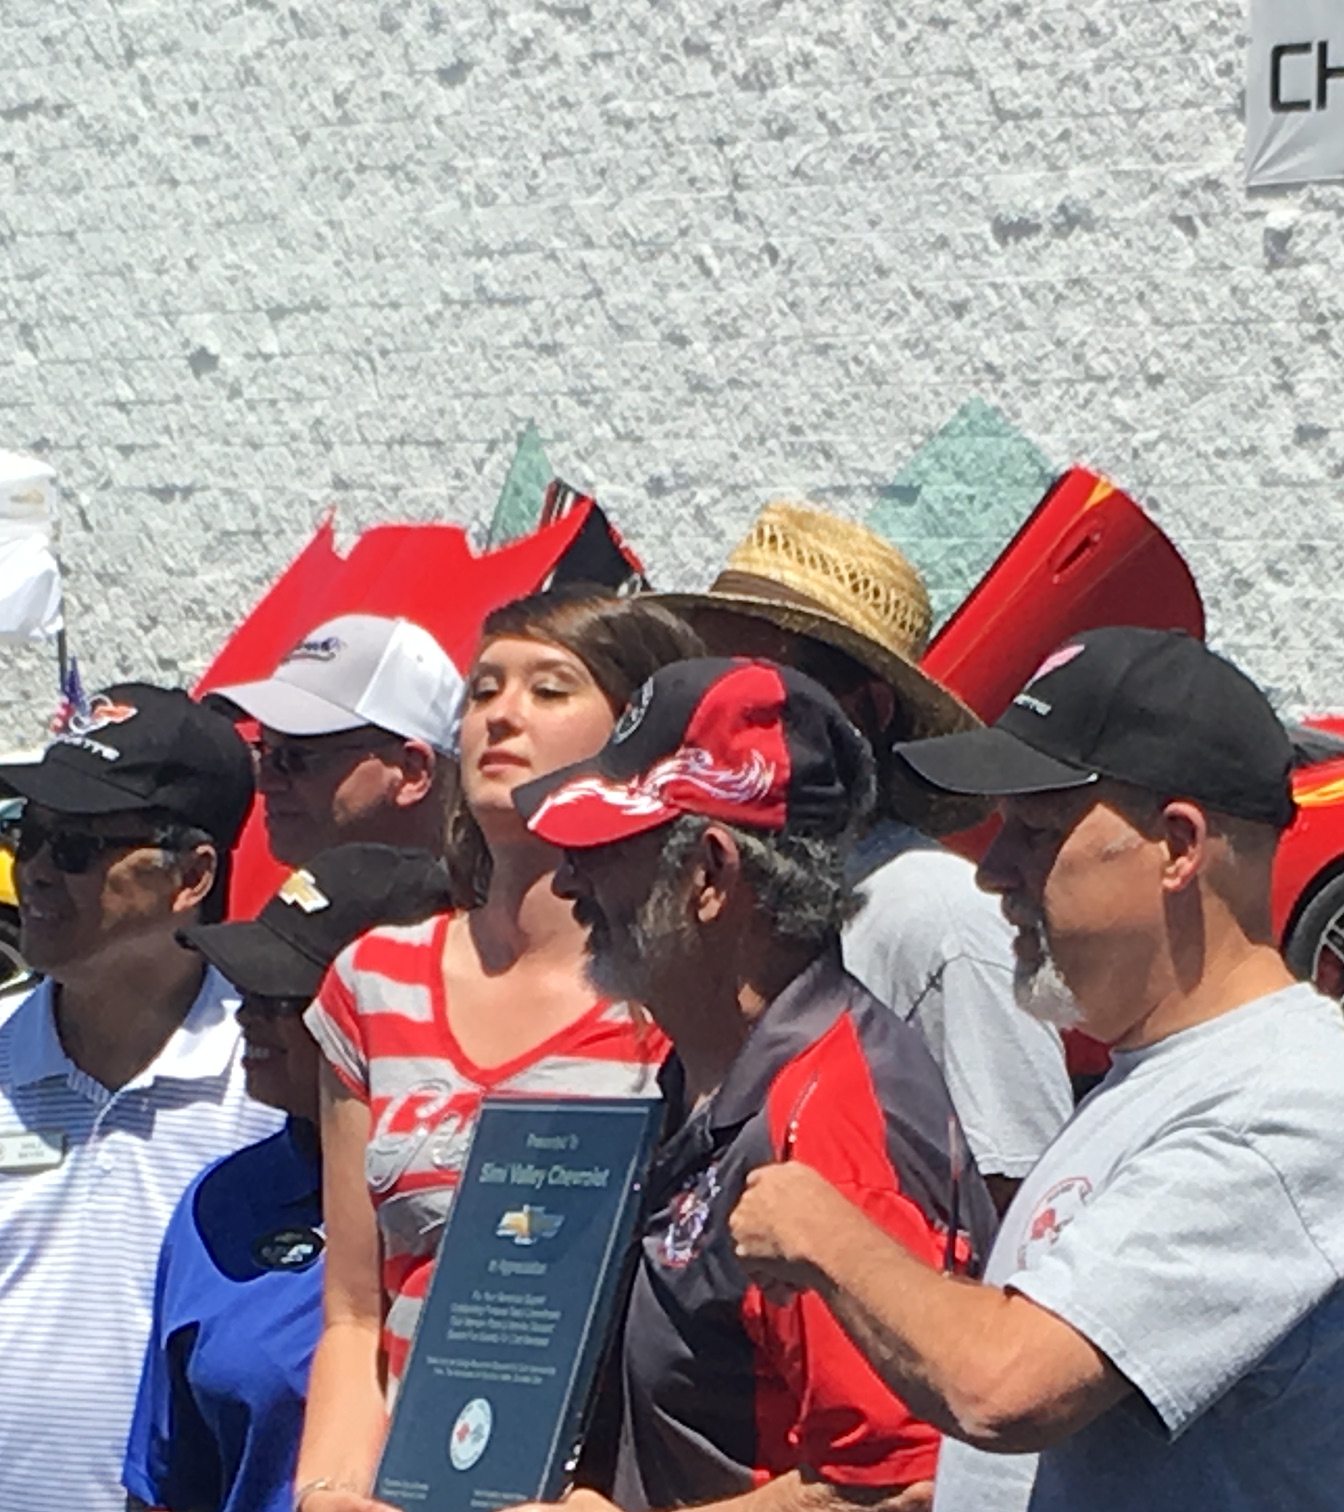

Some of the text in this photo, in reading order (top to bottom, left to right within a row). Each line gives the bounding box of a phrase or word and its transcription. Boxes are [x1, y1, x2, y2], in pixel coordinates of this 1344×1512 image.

[479, 1162, 610, 1189] Simi Valley Chevrolet
